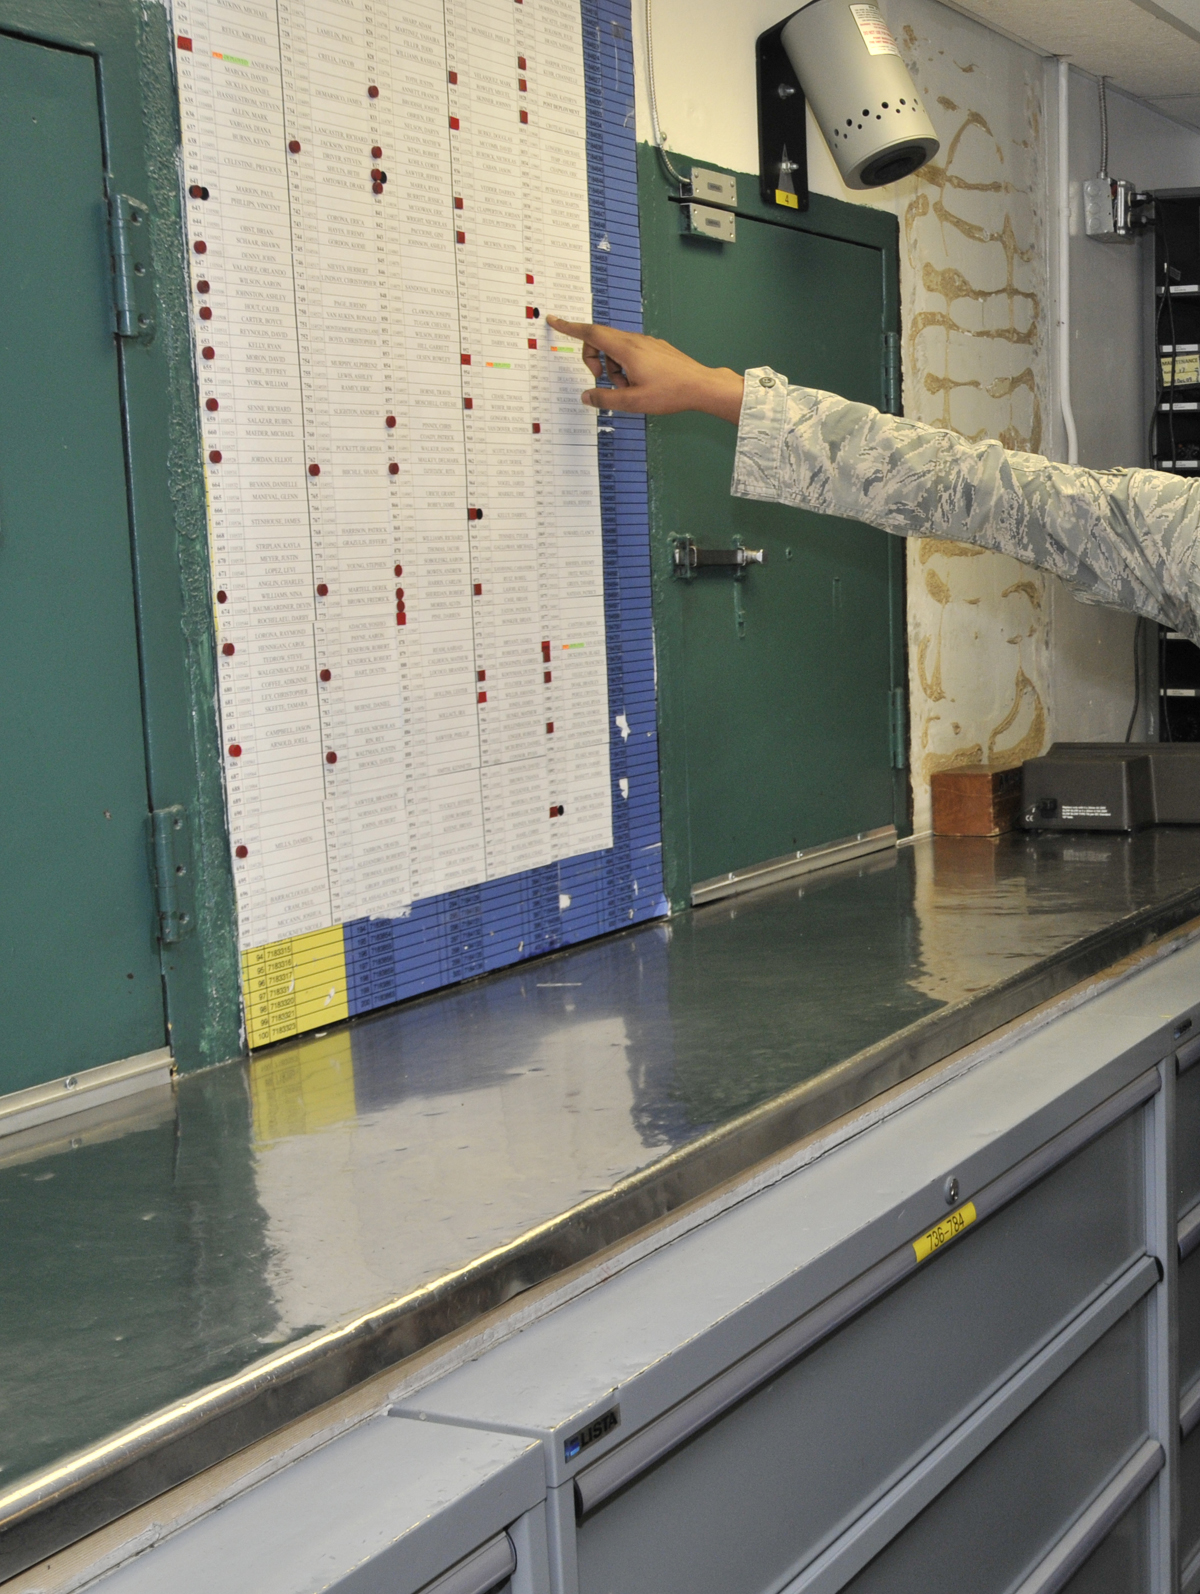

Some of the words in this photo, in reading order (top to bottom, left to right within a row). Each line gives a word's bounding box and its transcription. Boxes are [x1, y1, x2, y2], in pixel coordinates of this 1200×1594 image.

[1162, 358, 1198, 366] MAITENANCE
[268, 946, 291, 959] 7183315
[268, 959, 292, 972] 7183316
[269, 972, 293, 984] 7183317
[258, 992, 266, 1000] 97
[269, 986, 292, 997] 718331
[260, 1006, 267, 1014] 98
[271, 997, 294, 1010] 7183320
[261, 1018, 268, 1026] 99
[272, 1010, 294, 1023] 7183321
[258, 1032, 269, 1040] 100
[272, 1024, 296, 1036] 7183323
[927, 1213, 965, 1250] 736-784
[580, 1411, 618, 1448] LISTA
